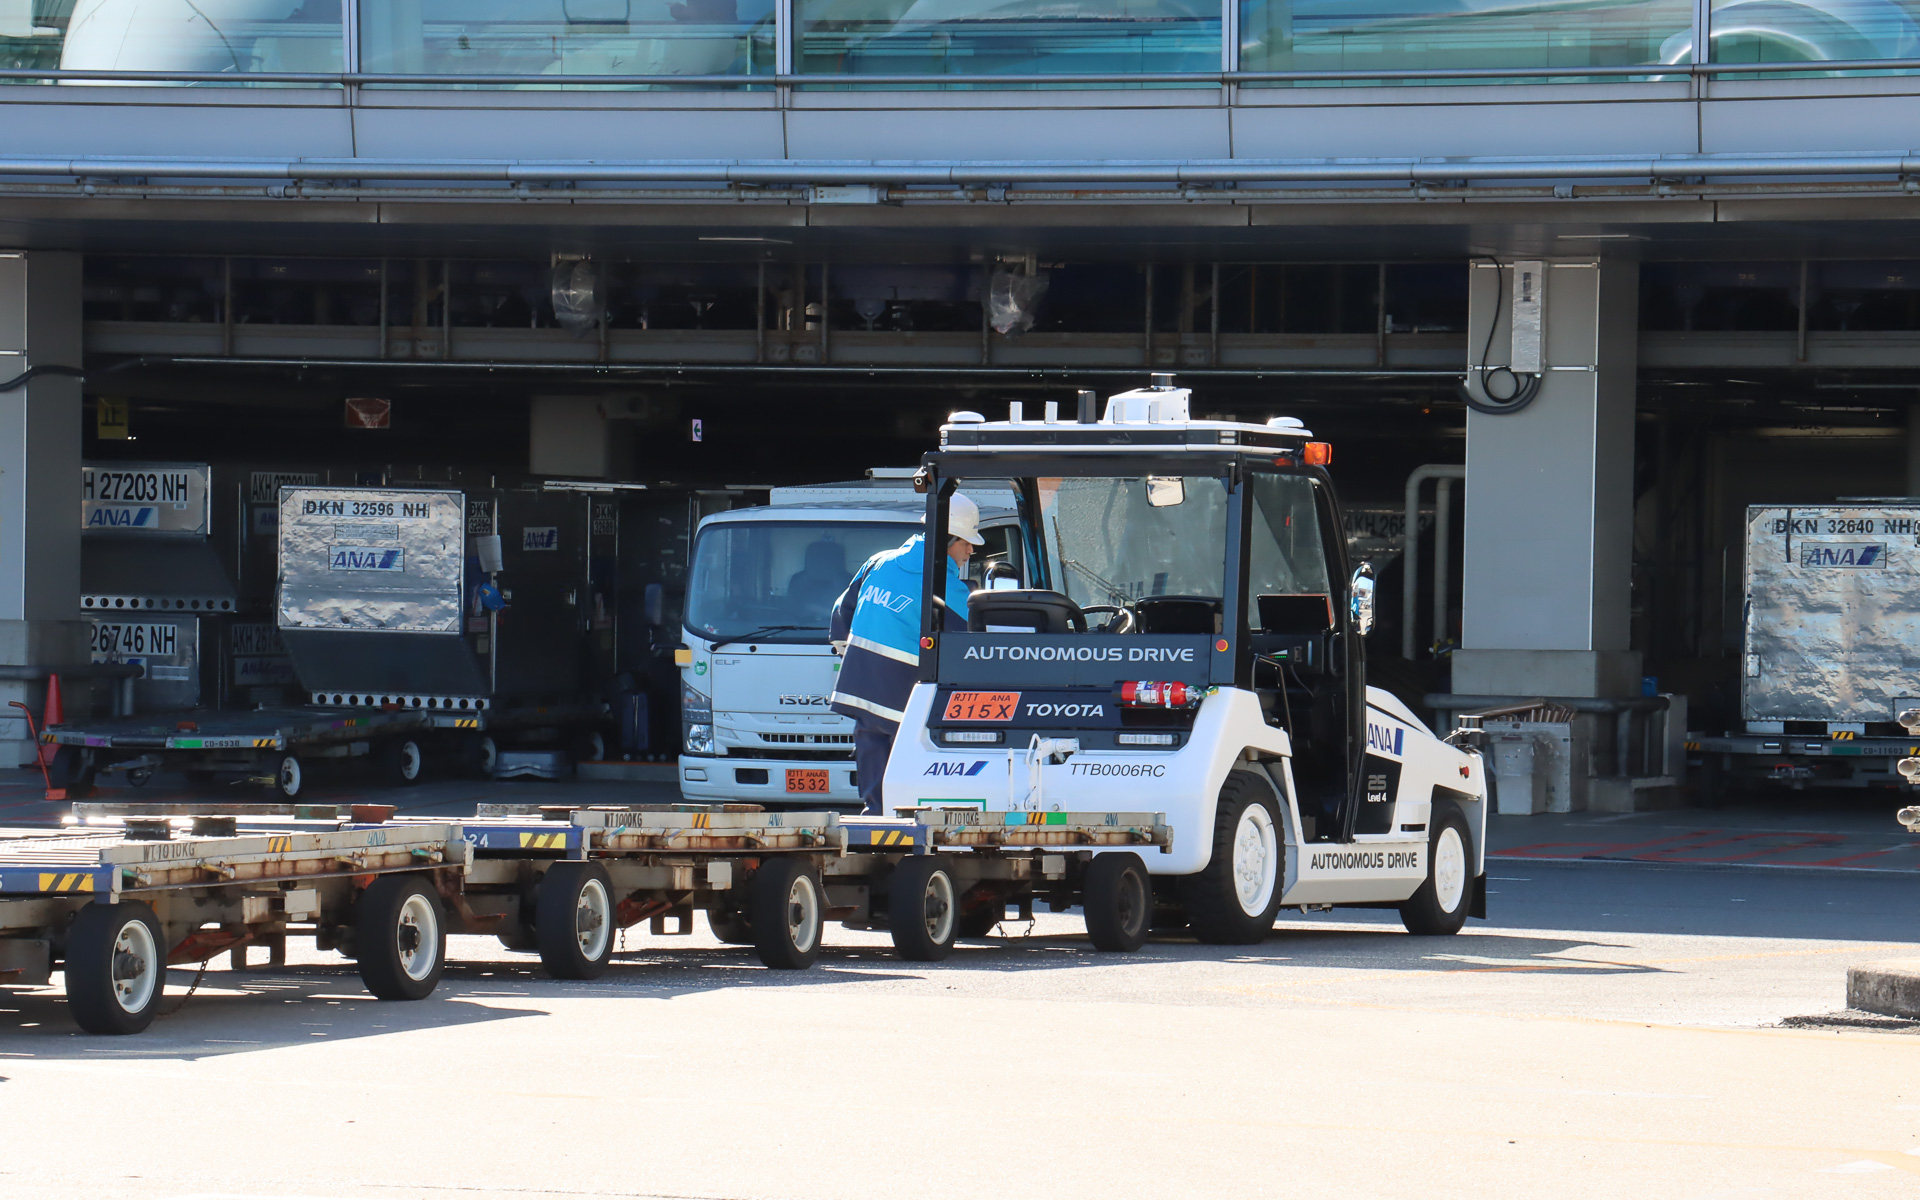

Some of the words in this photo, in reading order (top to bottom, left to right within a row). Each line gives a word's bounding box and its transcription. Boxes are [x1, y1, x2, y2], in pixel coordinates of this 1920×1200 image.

[100, 473, 158, 501] 27203
[162, 474, 188, 502] NH
[252, 474, 272, 501] AKH
[306, 500, 344, 515] DKN
[352, 502, 394, 516] 32596
[403, 503, 427, 517] NH
[471, 502, 489, 516] DKN
[88, 509, 131, 526] ANA
[1775, 519, 1818, 534] DKN
[1828, 519, 1874, 534] 32640
[1884, 519, 1911, 534] NH
[524, 532, 545, 549] ANA
[333, 551, 377, 569] ANA
[1806, 547, 1855, 566] ANA
[859, 585, 892, 608] ANA
[150, 626, 176, 653] NH
[964, 646, 1123, 661] AUTONOMOUS
[1128, 647, 1194, 662] DRIVE
[954, 693, 978, 702] RJTT
[990, 694, 1011, 702] ANA
[949, 704, 1012, 719] 315X
[1026, 703, 1104, 717] TOYOTA
[1366, 723, 1393, 754] ANA
[923, 762, 965, 776] ANA
[1071, 763, 1166, 777] TTB0006RC
[1367, 774, 1387, 791] 25
[1367, 792, 1381, 803] Level
[1381, 792, 1387, 802] 4
[1310, 852, 1384, 870] AUTONOMOUS
[1387, 851, 1418, 868] DRIVE
